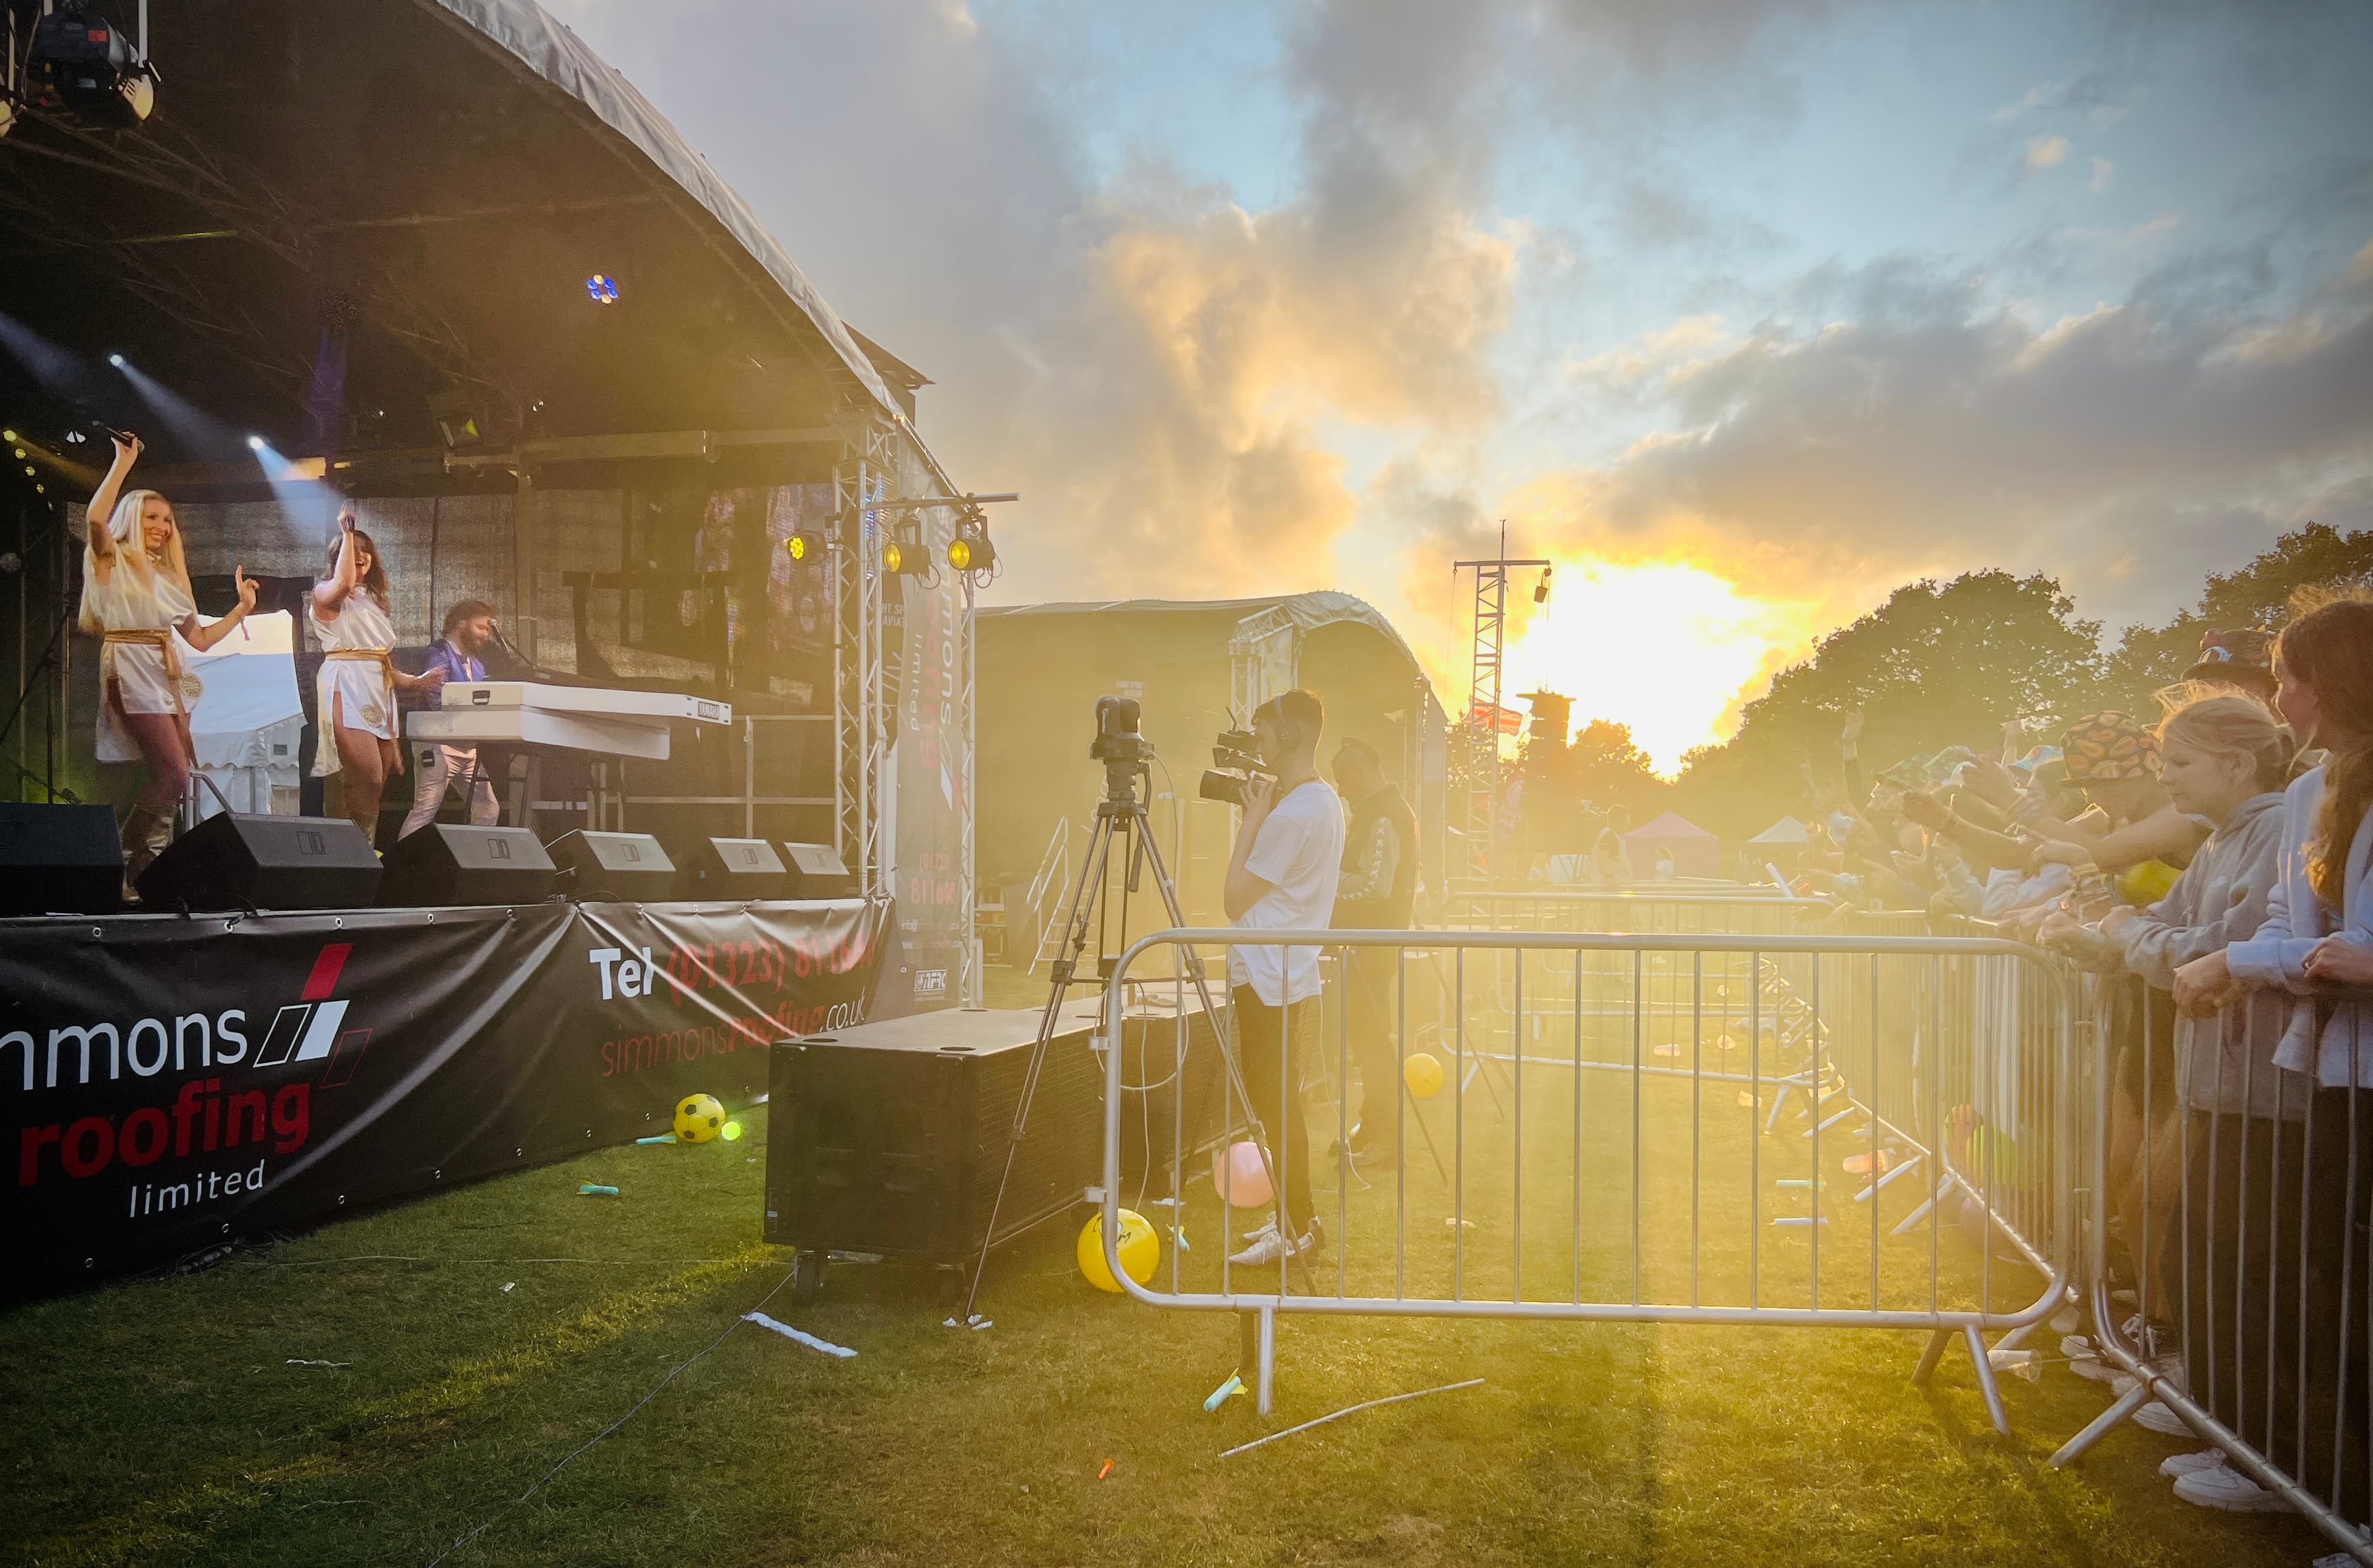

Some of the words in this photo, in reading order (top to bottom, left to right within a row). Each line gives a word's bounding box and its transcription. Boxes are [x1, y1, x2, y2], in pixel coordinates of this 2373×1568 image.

[910, 633, 924, 731] limited
[589, 946, 654, 1000] Tel
[666, 938, 785, 1006] (01323)
[19, 1078, 310, 1187] roofing
[129, 1159, 266, 1218] limited
